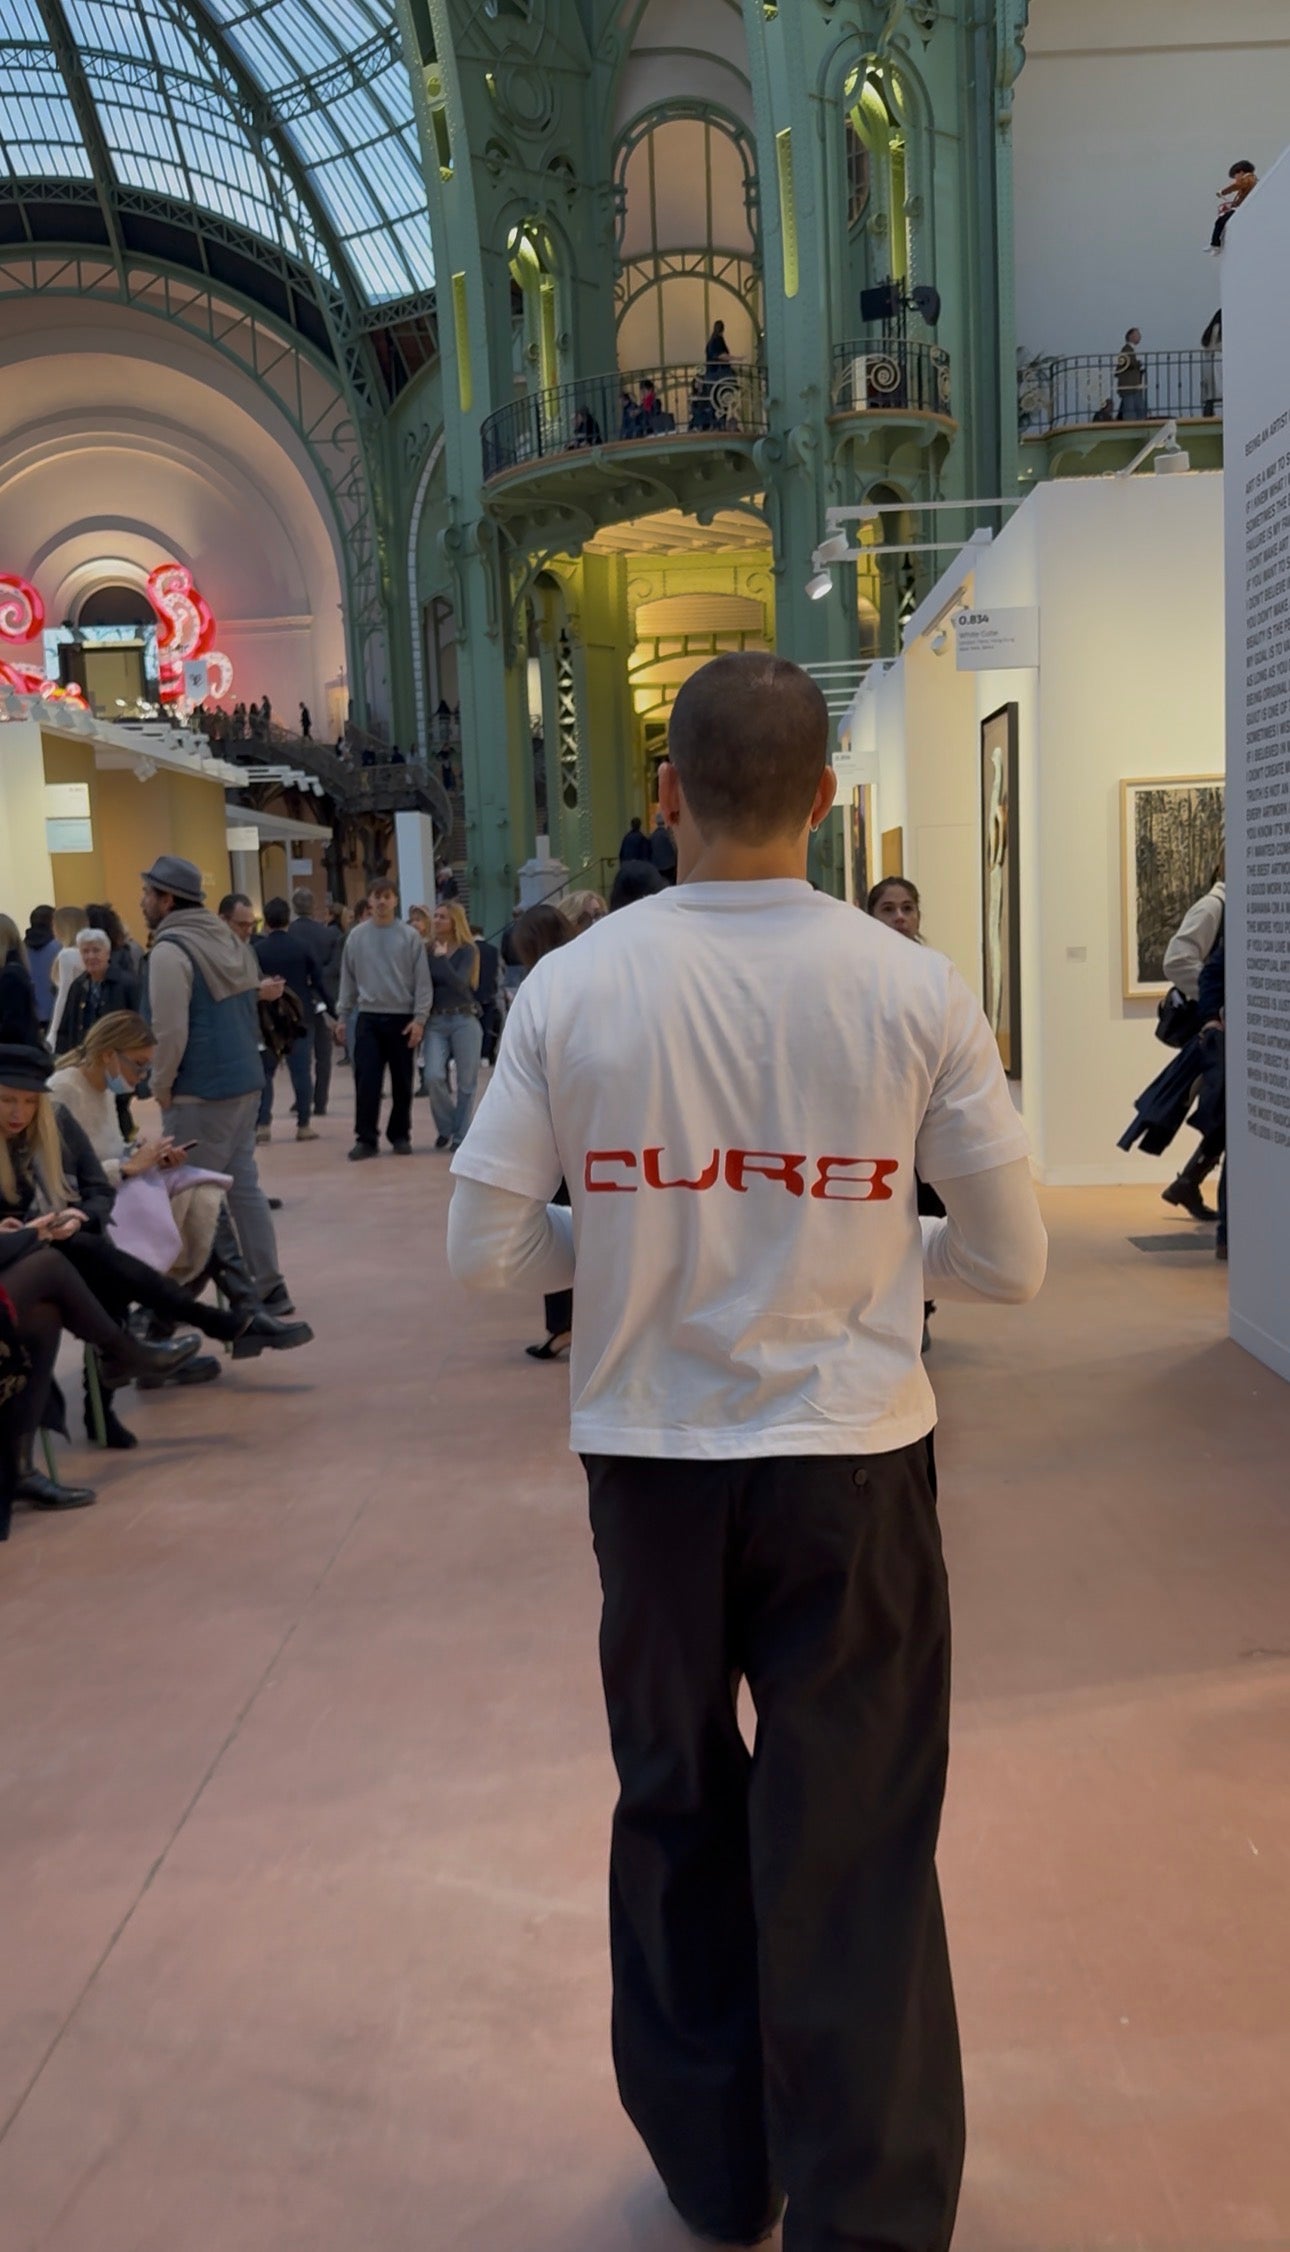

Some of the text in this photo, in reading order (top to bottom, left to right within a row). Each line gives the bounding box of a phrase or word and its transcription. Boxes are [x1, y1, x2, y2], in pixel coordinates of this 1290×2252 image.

[1270, 411, 1287, 436] ARTIST
[1246, 503, 1275, 534] SOMETIMES
[1276, 495, 1287, 514] THE
[1278, 536, 1288, 553] ART
[1264, 579, 1286, 601] BELIEVE
[1274, 598, 1288, 617] MAKE
[958, 614, 989, 625] 0.834
[1273, 620, 1283, 637] THE
[1276, 659, 1287, 676] YOU
[1246, 724, 1276, 744] SOMETIMES
[585, 1148, 899, 1201] CUR8
